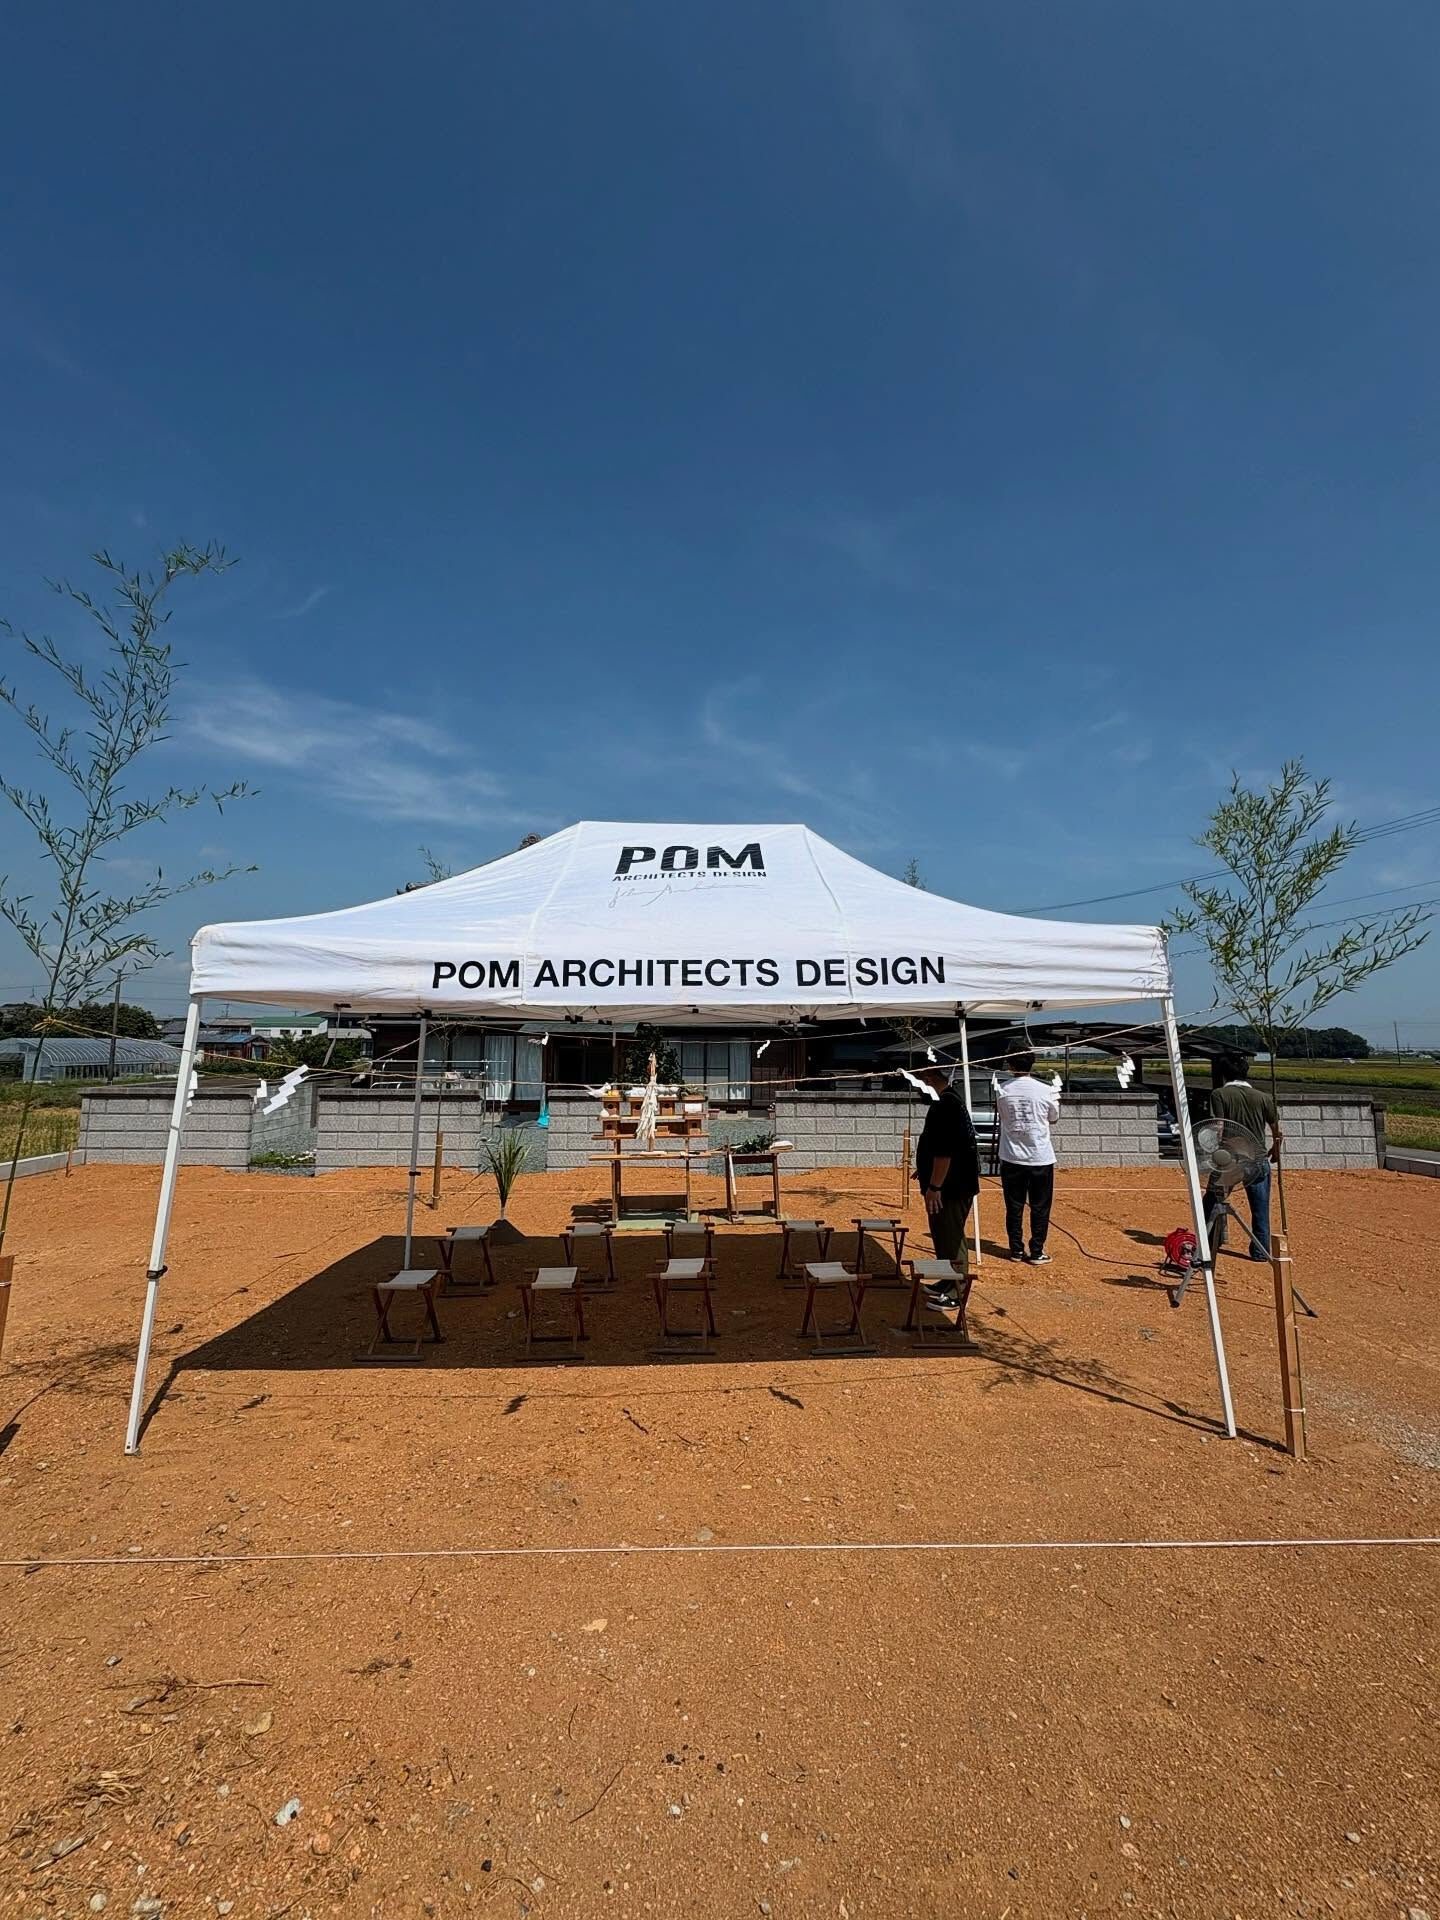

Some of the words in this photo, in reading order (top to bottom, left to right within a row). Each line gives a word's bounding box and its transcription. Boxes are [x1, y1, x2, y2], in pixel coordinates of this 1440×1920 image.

[615, 843, 765, 875] POM
[612, 871, 706, 882] ARCHITECTS
[433, 960, 520, 989] POM
[533, 958, 780, 988] ARCHITECTS
[796, 956, 946, 987] DESIGN
